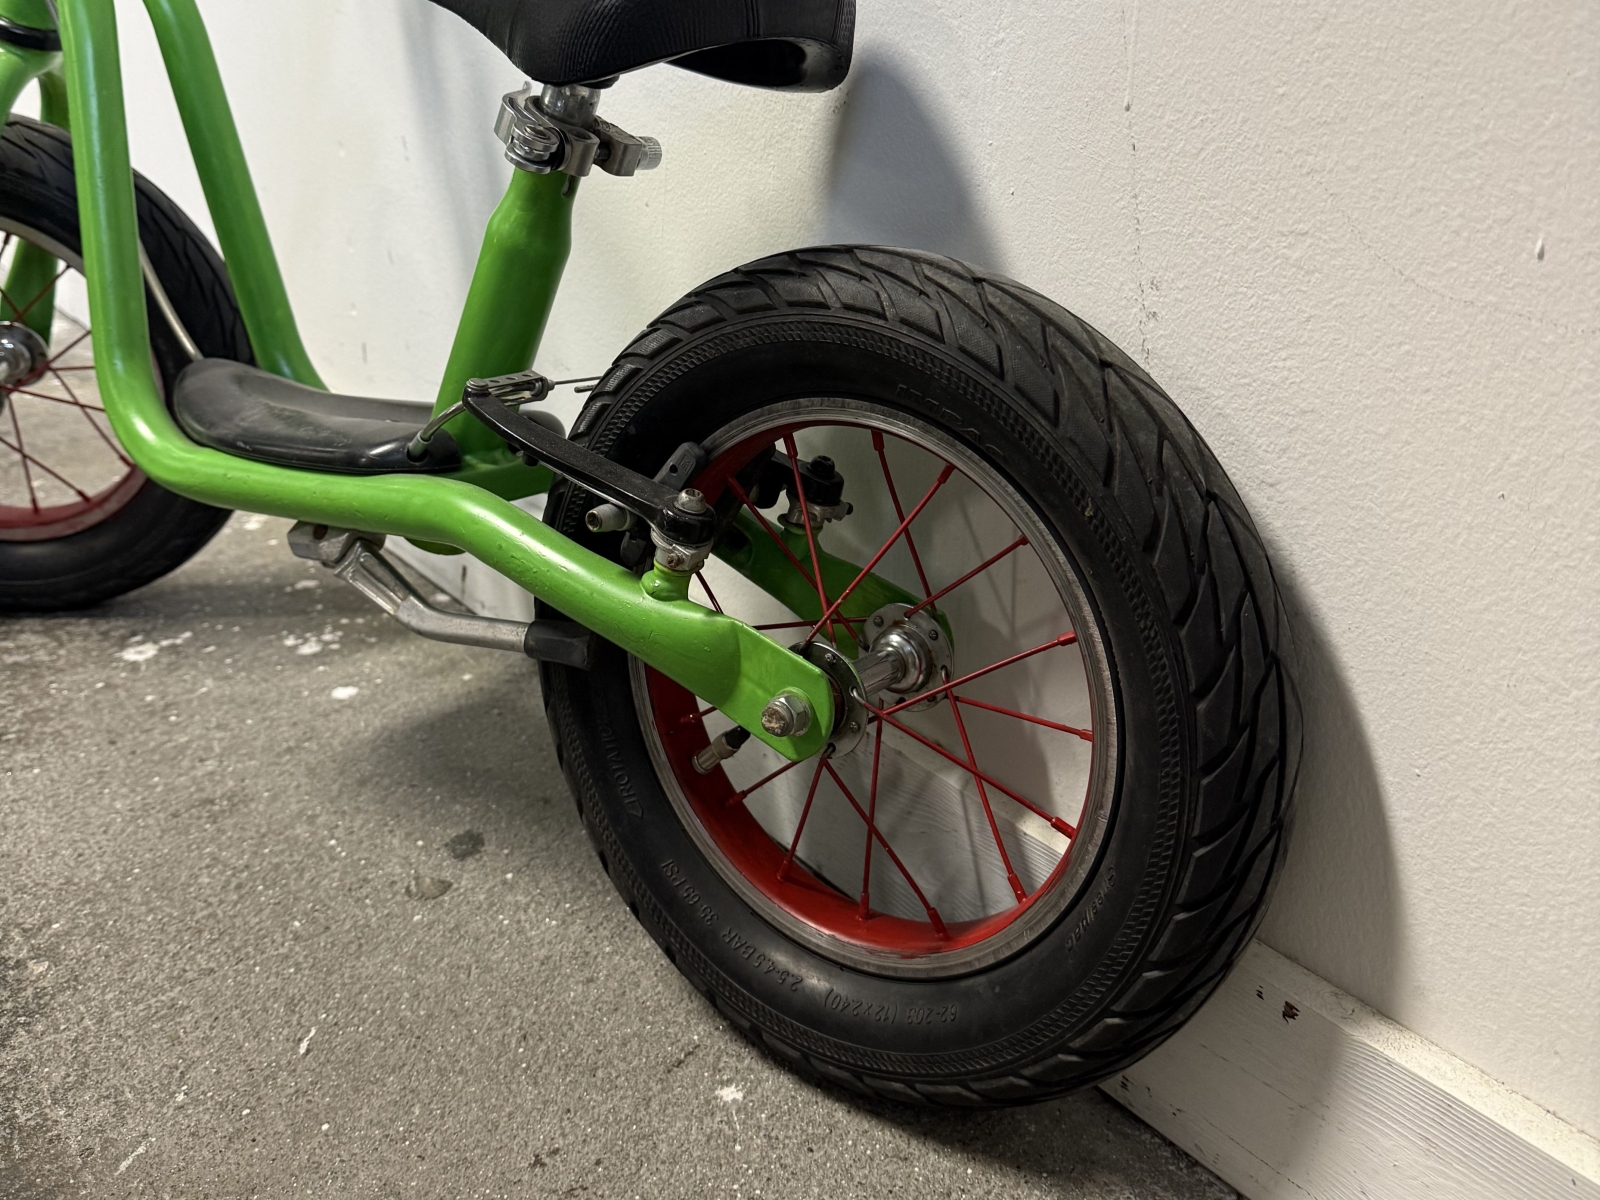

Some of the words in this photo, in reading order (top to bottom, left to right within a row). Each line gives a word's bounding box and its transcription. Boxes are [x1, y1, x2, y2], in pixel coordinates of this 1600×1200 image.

[659, 858, 686, 888] PSI
[678, 884, 720, 927] 35-65
[720, 927, 757, 962] BAR
[751, 952, 804, 992] 2.5-4.5
[905, 1003, 957, 1024] 62-203
